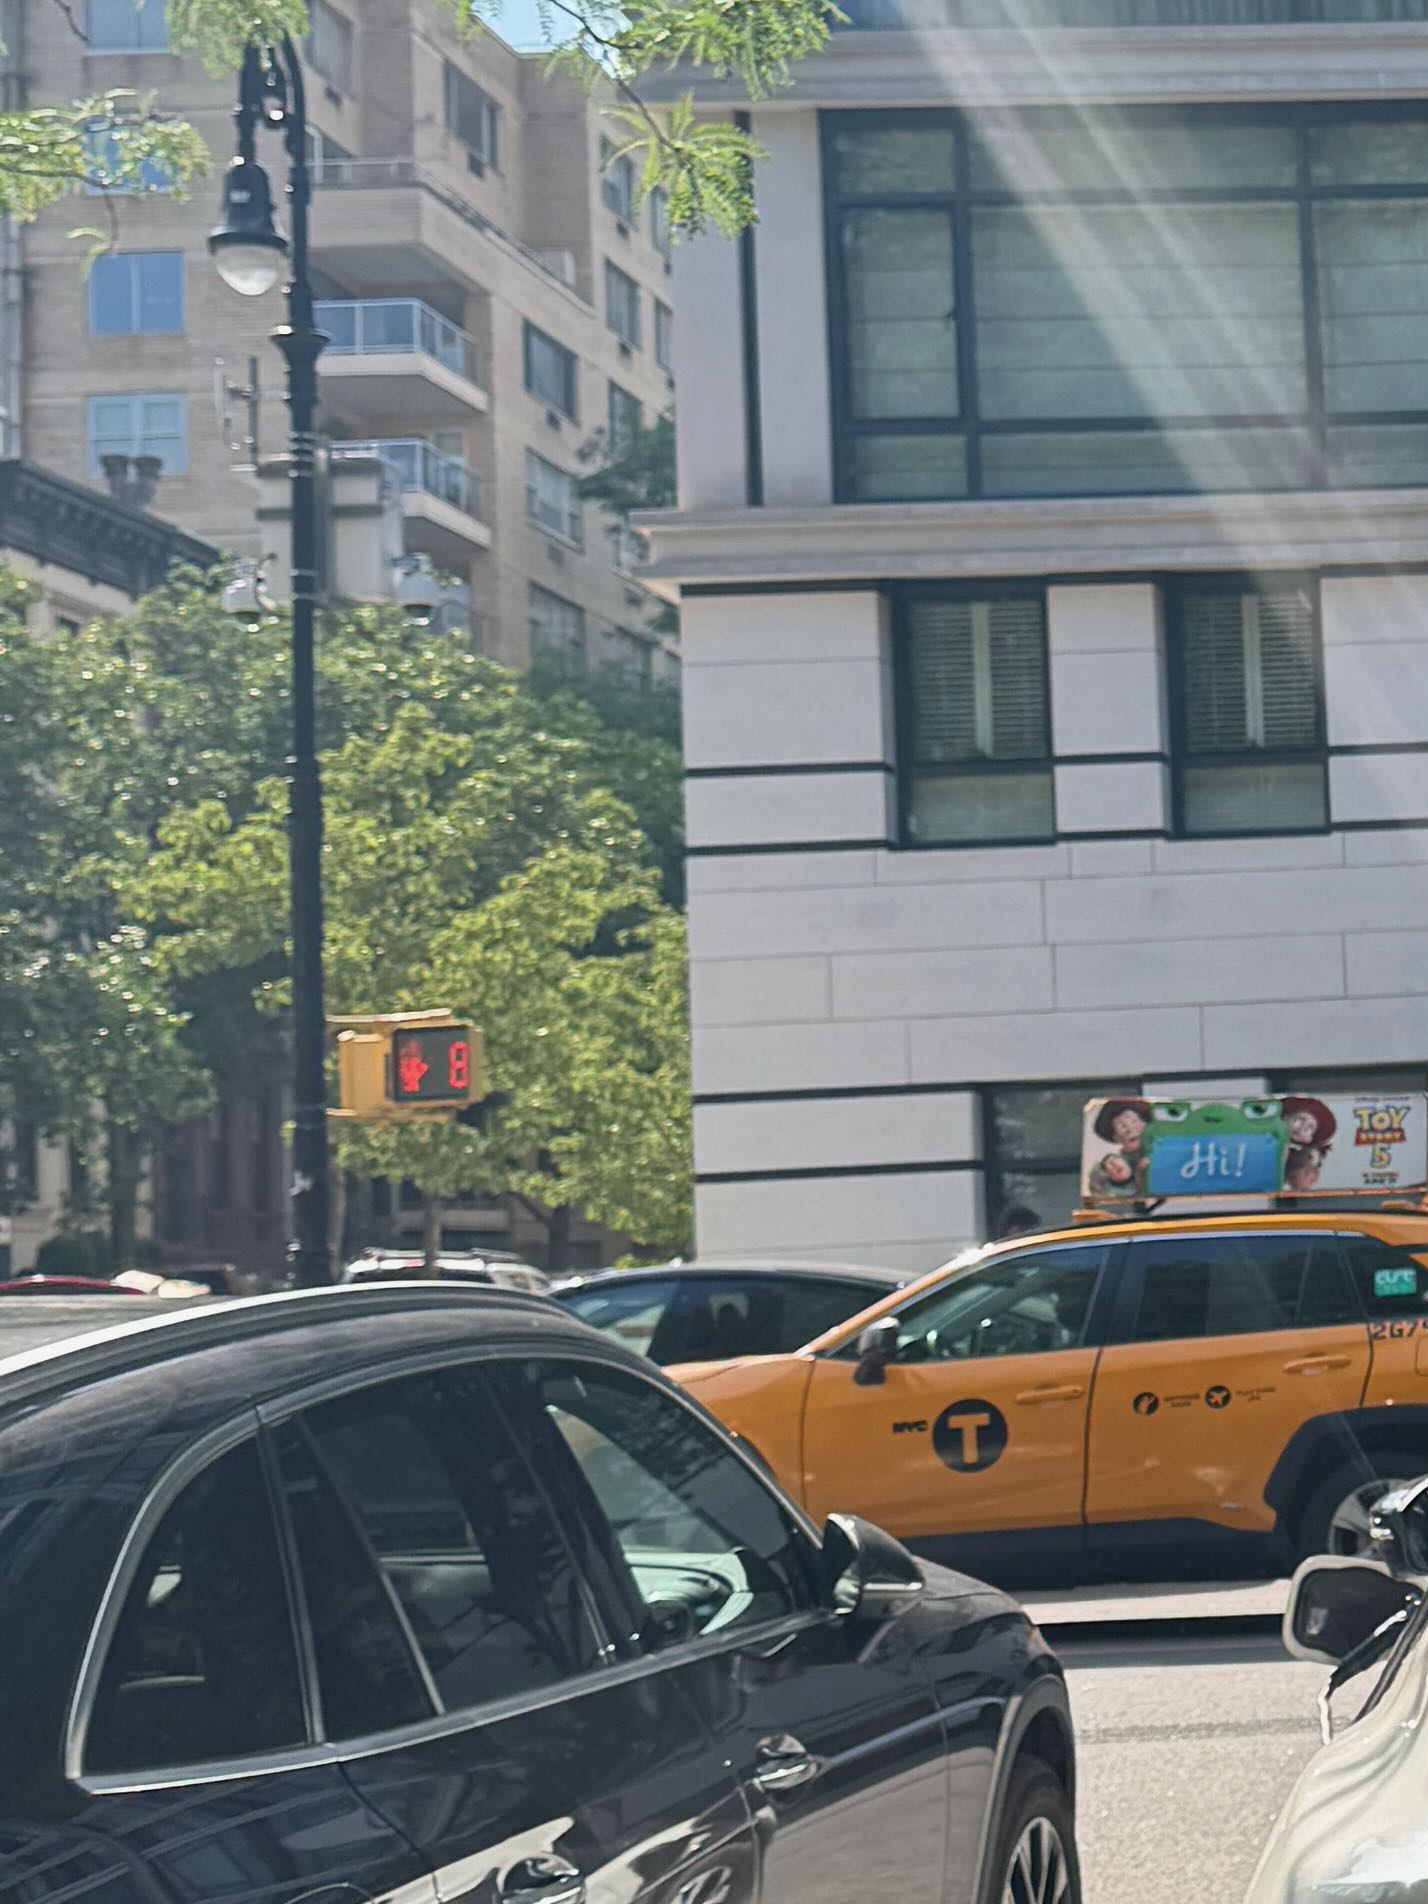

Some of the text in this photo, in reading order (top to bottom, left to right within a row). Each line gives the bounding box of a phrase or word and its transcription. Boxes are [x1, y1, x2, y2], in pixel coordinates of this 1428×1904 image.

[448, 1041, 469, 1089] 8
[1353, 1105, 1411, 1131] TOY
[1180, 1141, 1248, 1179] Hi!
[1370, 1143, 1392, 1169] 5
[948, 1413, 990, 1464] T
